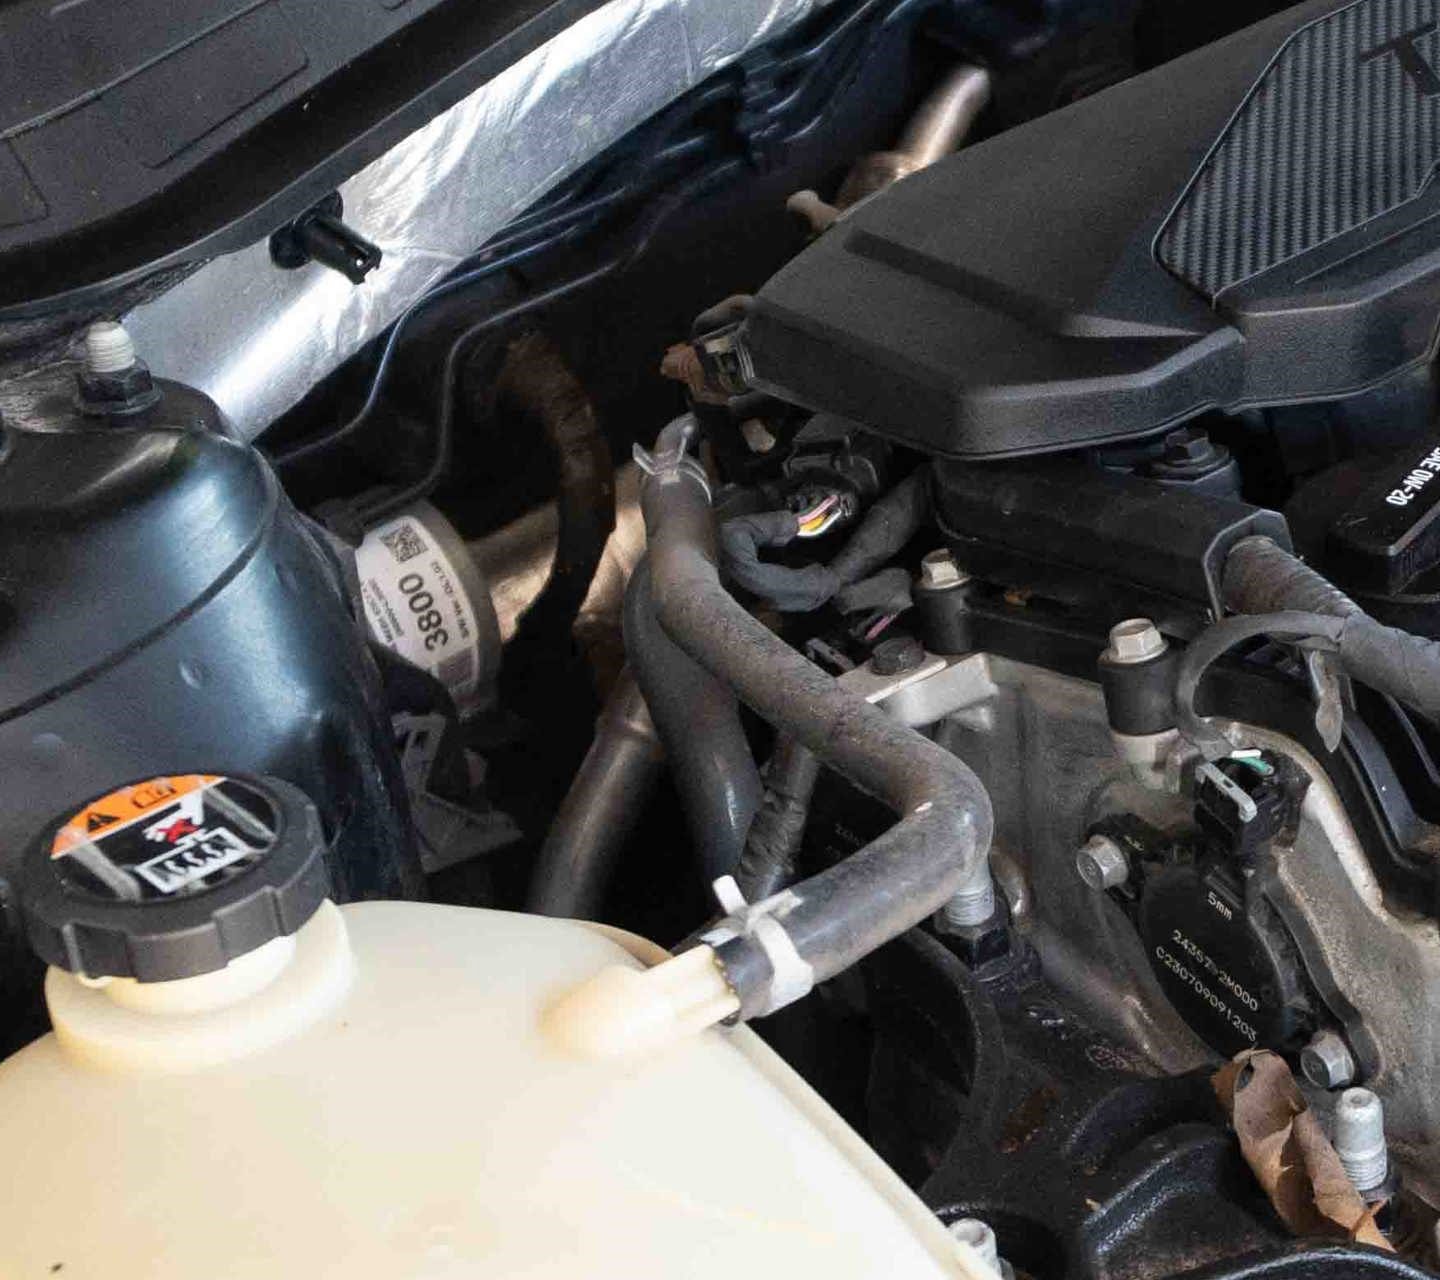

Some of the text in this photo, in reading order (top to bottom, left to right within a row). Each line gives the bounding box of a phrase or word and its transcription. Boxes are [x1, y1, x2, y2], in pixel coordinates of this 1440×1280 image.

[1385, 468, 1435, 506] 0W-20
[397, 572, 450, 652] 3800
[1207, 890, 1233, 921] 5mm
